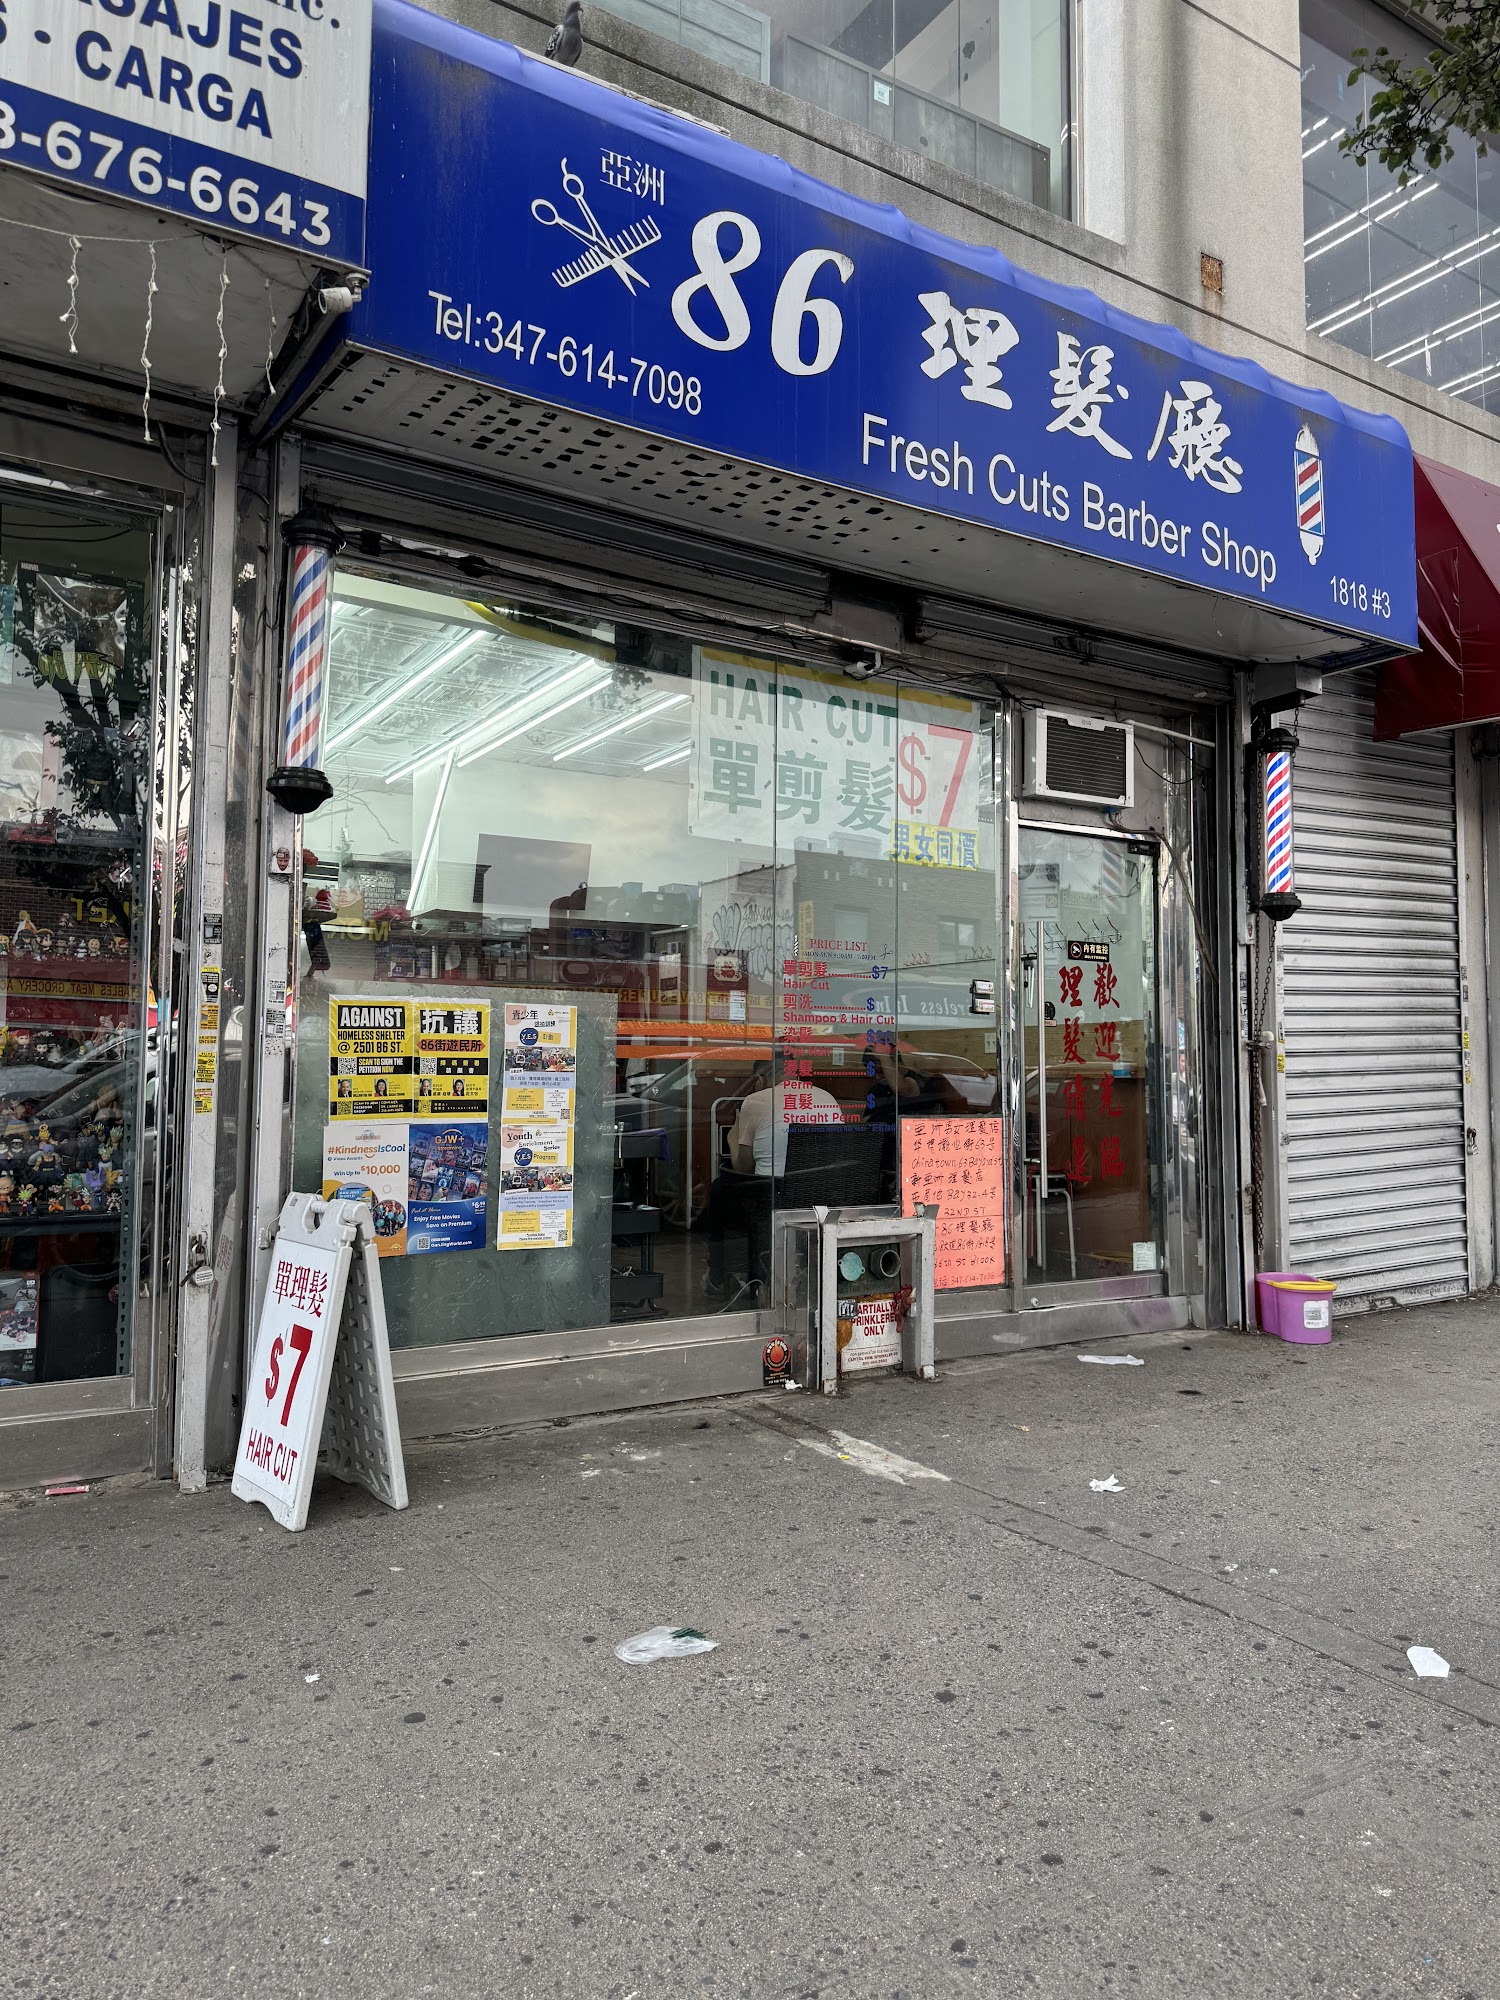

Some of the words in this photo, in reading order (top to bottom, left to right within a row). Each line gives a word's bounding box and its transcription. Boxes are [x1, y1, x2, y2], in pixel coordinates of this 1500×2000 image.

[80, 0, 303, 79] AJES
[75, 30, 273, 139] CARGA
[600, 147, 665, 206] 亞洲
[428, 290, 702, 416] Tel:347-614-7098
[671, 210, 855, 376] 86
[917, 291, 1243, 494] 理髮廳
[862, 412, 974, 495] Fresh
[987, 453, 1070, 522] Cuts
[1082, 482, 1191, 560] Barber
[1201, 521, 1277, 592] Shop
[21, 562, 39, 571] MARVEL
[1329, 575, 1369, 613] 1818
[1371, 592, 1391, 619] #3
[710, 670, 804, 732] HAIR
[825, 695, 898, 748] CUT
[898, 723, 974, 827] $7
[704, 737, 896, 835] 單剪髮
[893, 823, 977, 869] 男女同價
[810, 938, 843, 951] PRICE
[845, 940, 868, 952] LIST
[784, 960, 828, 978] 單剪髮
[872, 965, 889, 980] $7
[783, 978, 807, 991] Hair
[810, 980, 830, 991] Cut
[784, 993, 812, 1010] 剪洗
[867, 997, 875, 1012] $
[340, 1006, 403, 1028] AGAINST
[422, 1007, 479, 1035] 抗議
[513, 1010, 539, 1020] 青少年
[783, 1011, 837, 1025] Shampoo
[840, 1013, 848, 1024] &
[851, 1014, 874, 1025] Hair
[876, 1015, 895, 1026] Cut
[338, 1031, 374, 1041] HOMELESS
[375, 1031, 406, 1041] SHELTER
[866, 1028, 893, 1044] $20
[337, 1041, 351, 1055] @
[353, 1041, 375, 1054] 2501
[376, 1041, 388, 1053] 86
[390, 1042, 404, 1053] ST.
[420, 1040, 482, 1051] 86街遊民所
[783, 1045, 806, 1058] Dye
[808, 1047, 832, 1057] Hair
[358, 1058, 373, 1066] SCAN
[374, 1058, 381, 1066] TO
[381, 1058, 394, 1066] SIGN
[394, 1057, 404, 1066] THE
[867, 1061, 876, 1077] $
[358, 1066, 381, 1074] PETITION
[783, 1080, 813, 1090] Perm
[783, 1094, 813, 1111] 直髮
[867, 1093, 876, 1109] $
[783, 1112, 829, 1126] Straight
[832, 1113, 861, 1124] Perm
[507, 1131, 533, 1142] Youth
[519, 1140, 553, 1148] Enrichment
[328, 1143, 406, 1155] #KindnessIsCool
[533, 1152, 556, 1161] Program
[361, 1164, 401, 1176] $10,000
[973, 1206, 987, 1216] ST
[414, 1215, 429, 1223] Enjoy
[272, 1259, 328, 1318] 單理髮
[863, 1325, 885, 1337] ONLY
[265, 1323, 314, 1428] $7
[245, 1427, 272, 1473] HAIR
[272, 1442, 298, 1486] CUT
